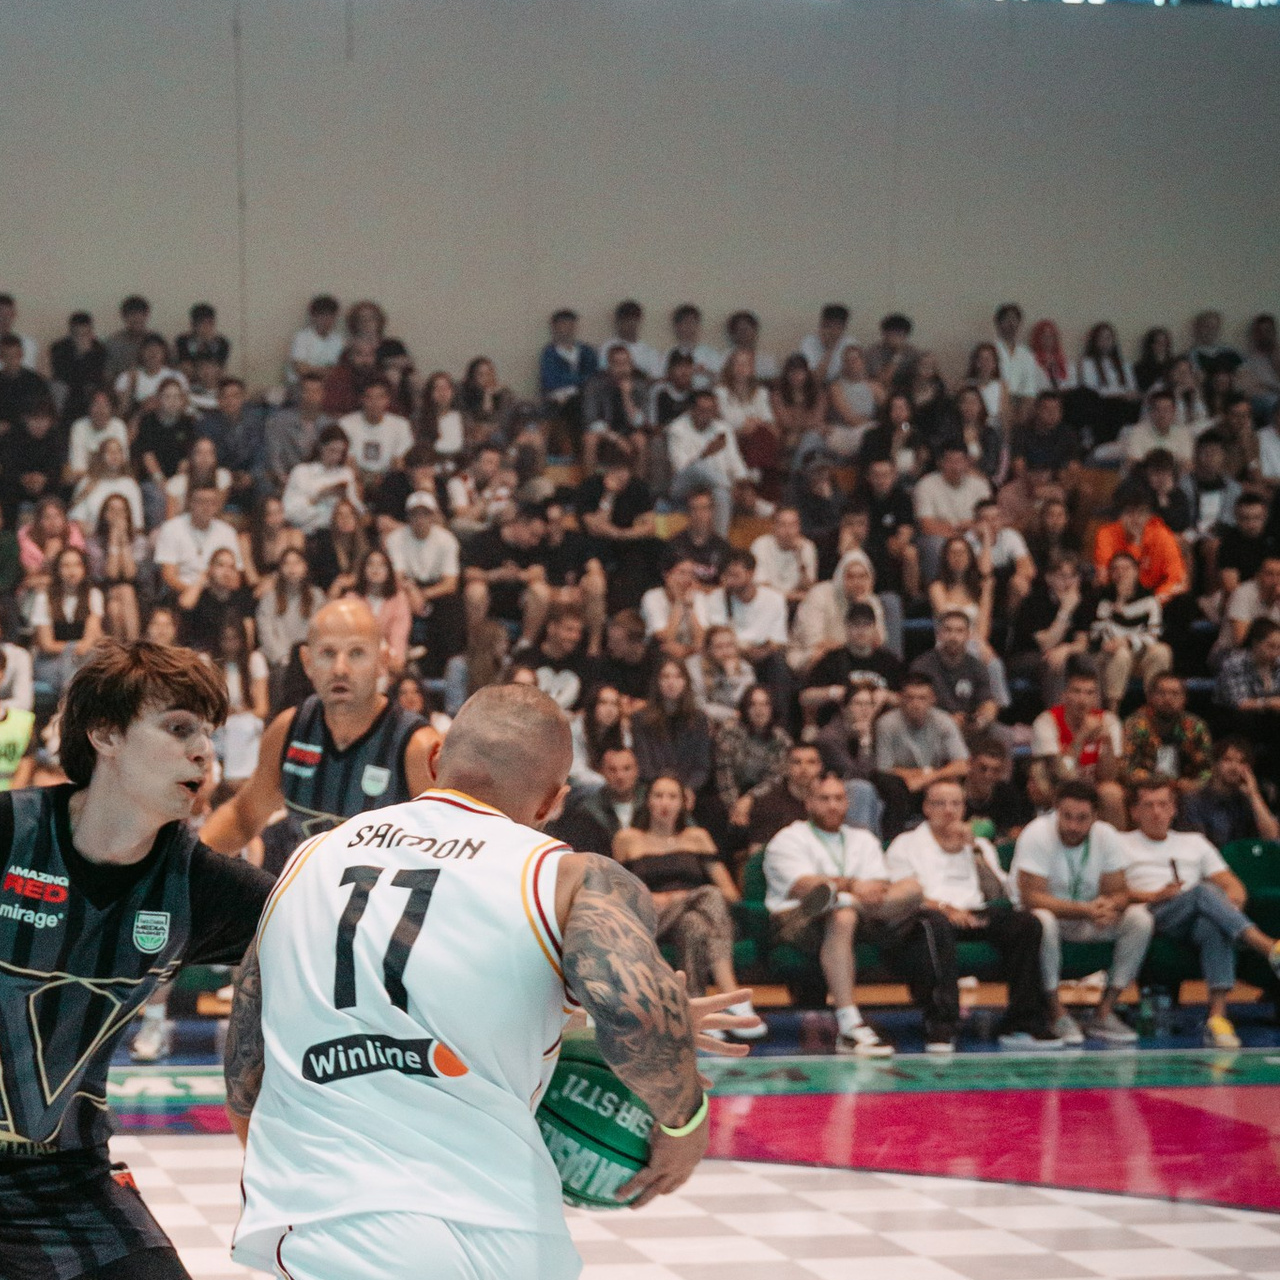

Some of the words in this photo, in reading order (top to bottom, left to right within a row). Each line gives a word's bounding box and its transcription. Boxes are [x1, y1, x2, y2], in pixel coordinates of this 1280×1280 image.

[2, 873, 69, 903] RED
[8, 865, 69, 888] AMAZING
[334, 865, 441, 1014] 11
[309, 1040, 421, 1077] Winline
